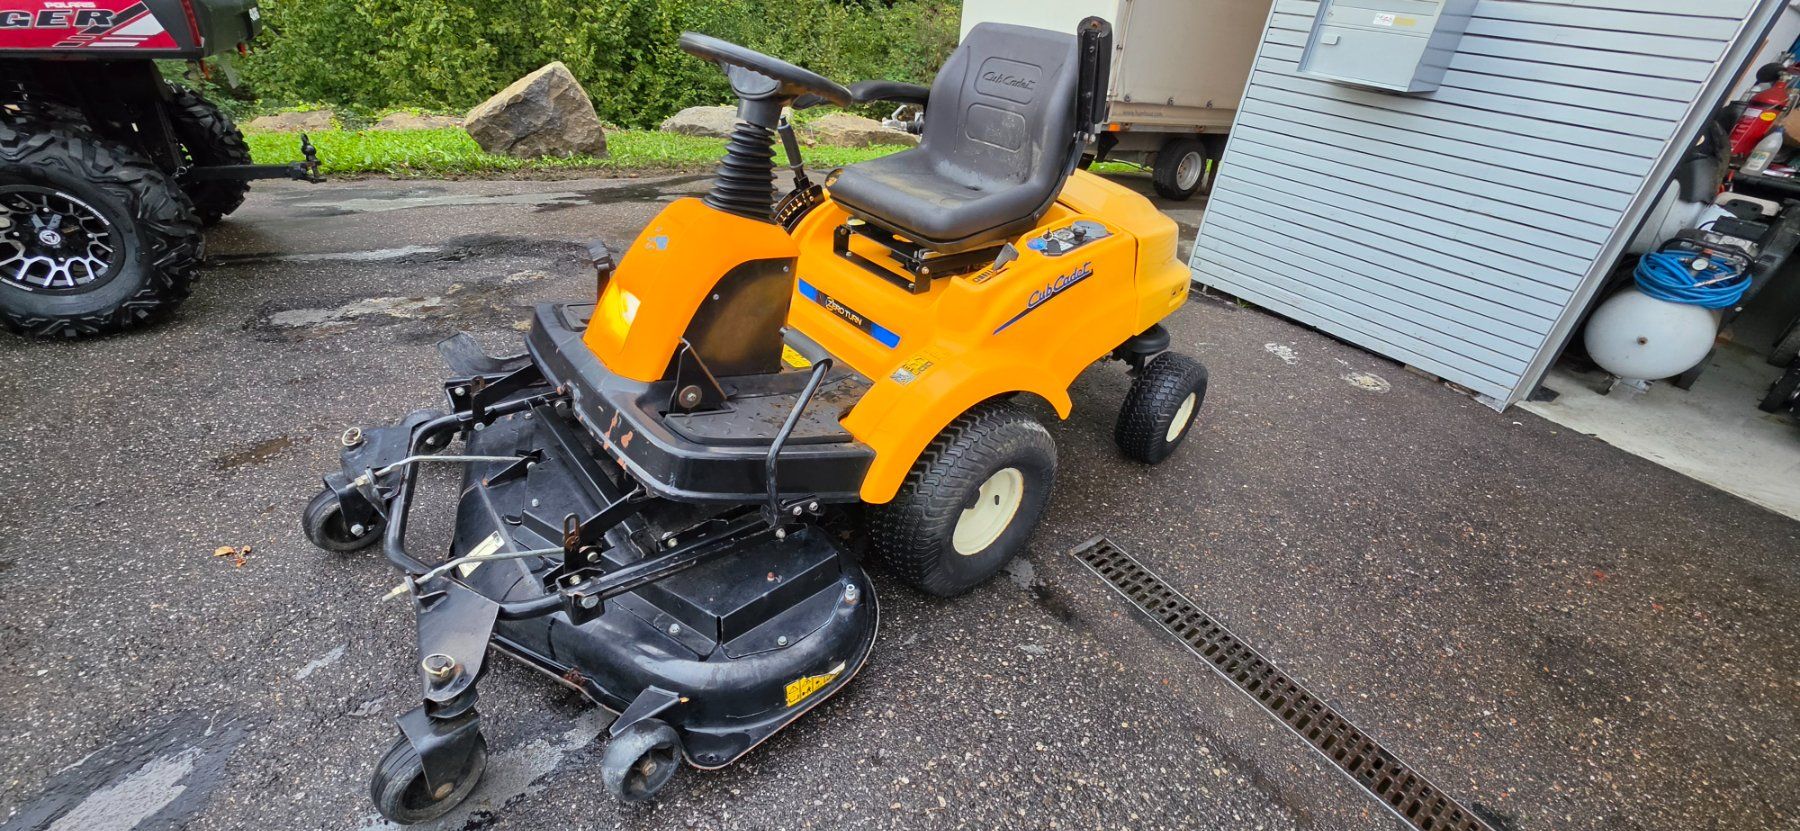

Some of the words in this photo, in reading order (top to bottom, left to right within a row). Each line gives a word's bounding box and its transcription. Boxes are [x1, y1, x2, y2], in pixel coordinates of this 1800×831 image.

[983, 71, 1003, 84] Cub
[1002, 75, 1036, 91] Cadet
[1028, 283, 1053, 308] Cub
[1053, 261, 1092, 292] Cadet
[825, 296, 845, 315] ZERO
[844, 309, 863, 326] TURN
